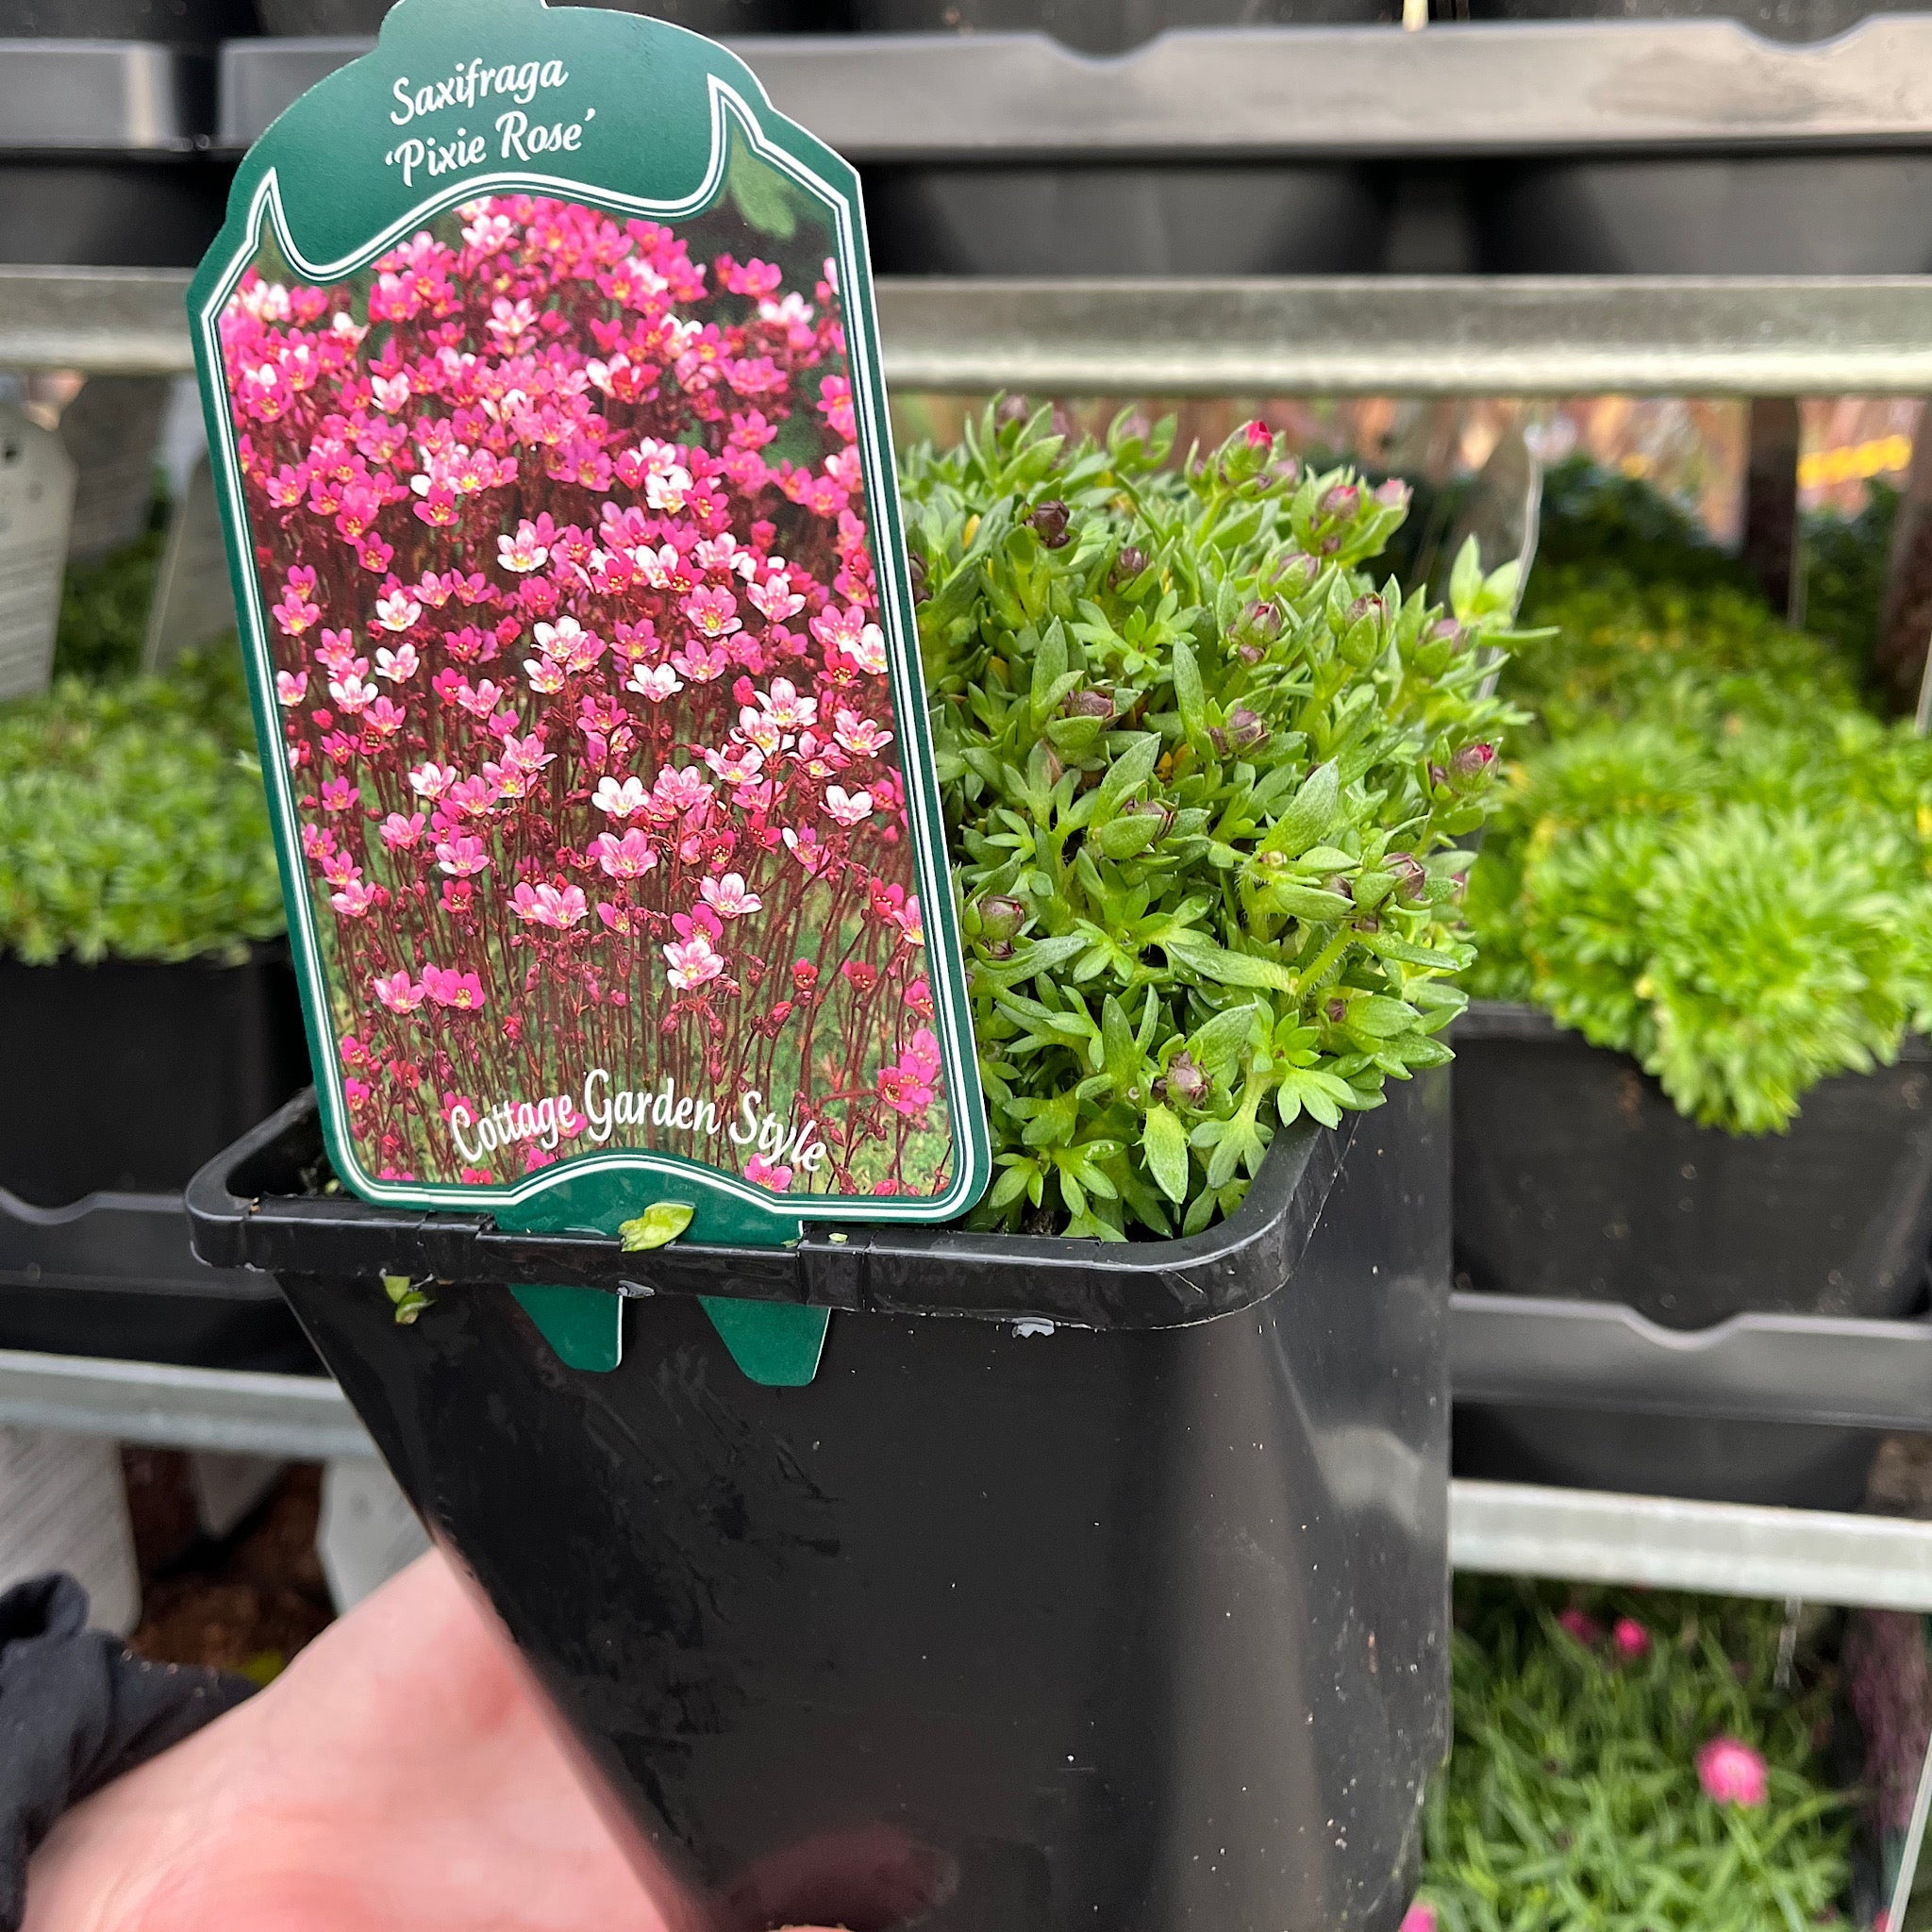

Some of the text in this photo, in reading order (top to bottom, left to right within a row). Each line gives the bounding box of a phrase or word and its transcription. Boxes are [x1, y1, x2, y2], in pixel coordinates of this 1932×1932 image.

[390, 57, 570, 126] Saxifraga
[449, 1067, 828, 1173] Cottage Garden Style
